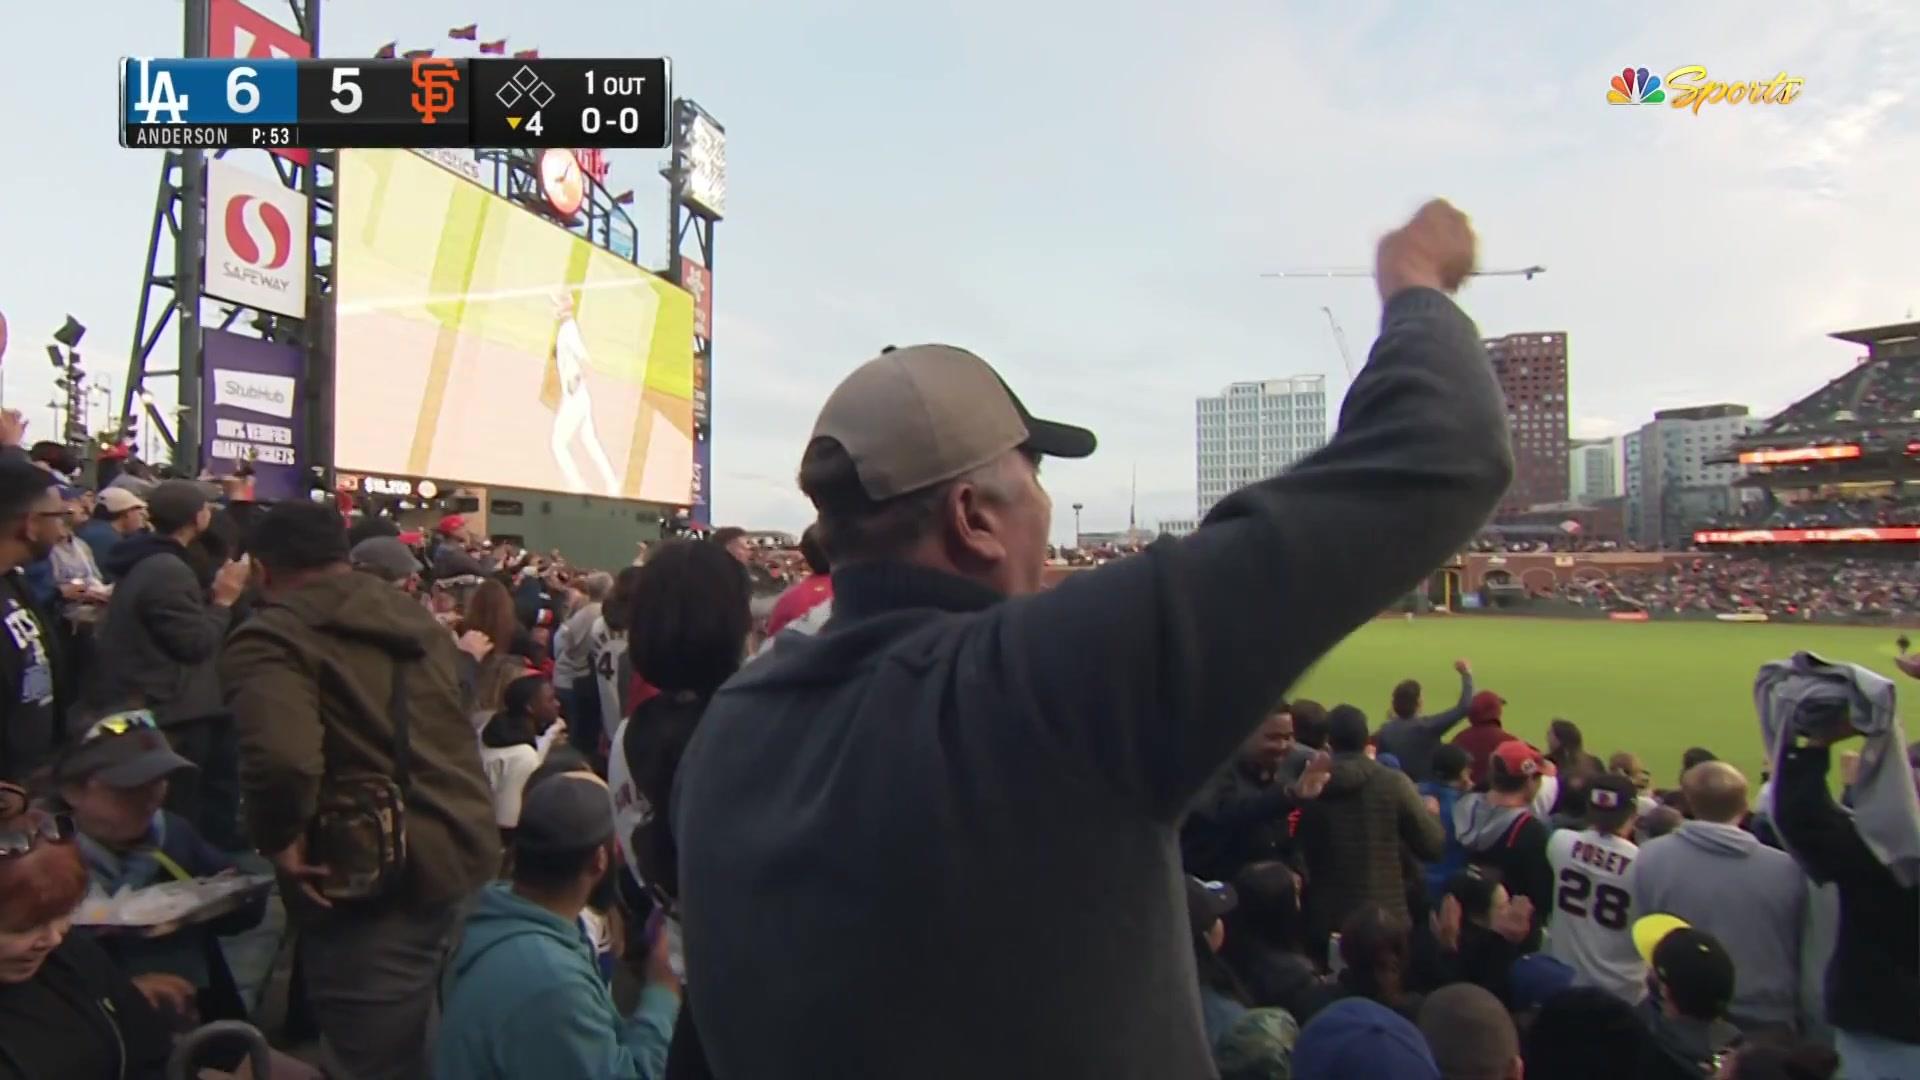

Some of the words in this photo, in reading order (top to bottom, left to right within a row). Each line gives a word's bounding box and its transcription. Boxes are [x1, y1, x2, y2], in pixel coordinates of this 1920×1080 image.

[222, 261, 290, 293] SAFEWAY
[224, 380, 285, 405] StubHub
[1571, 840, 1632, 876] POSEY
[1558, 867, 1631, 930] 28
